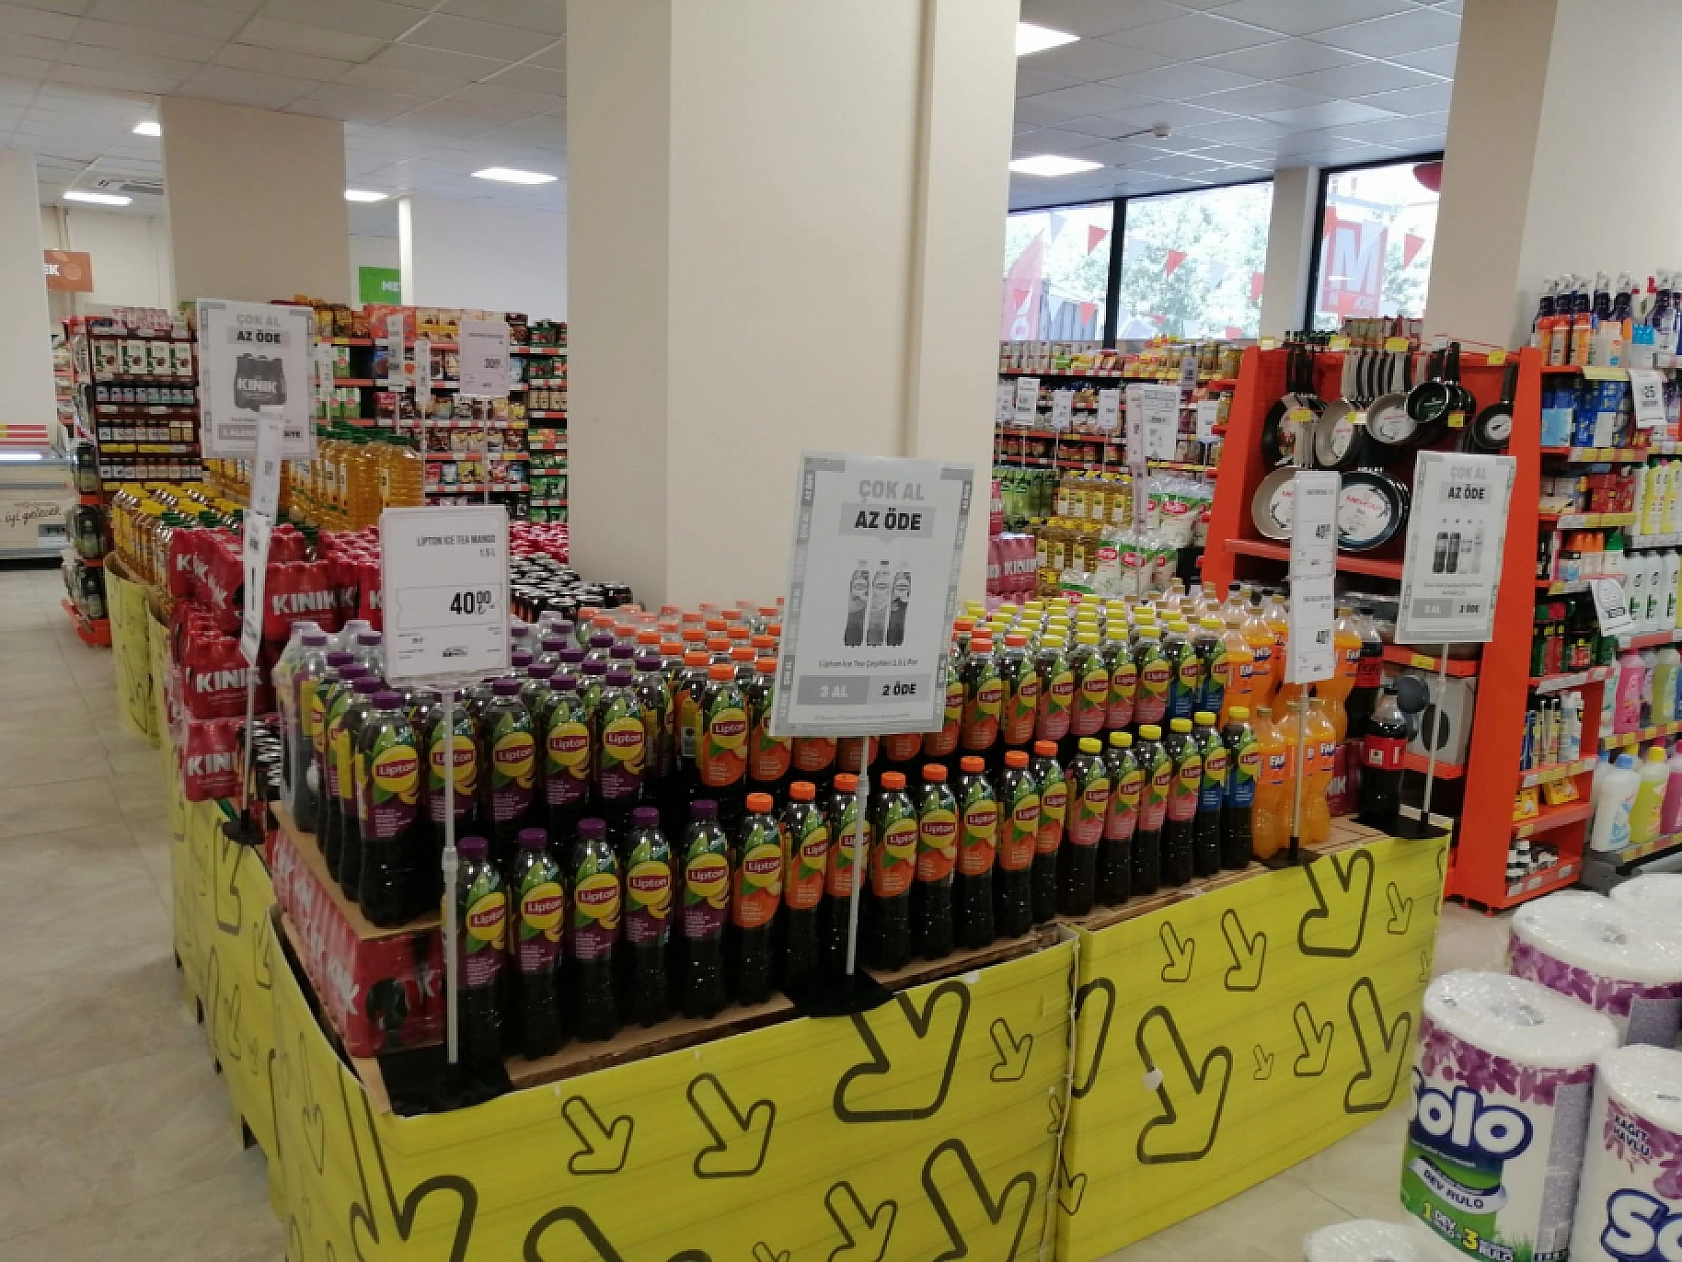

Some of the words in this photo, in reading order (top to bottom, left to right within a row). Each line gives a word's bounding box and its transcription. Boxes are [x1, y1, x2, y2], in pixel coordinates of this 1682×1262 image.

[236, 330, 253, 342] AZ
[255, 328, 282, 344] ÖDE
[859, 479, 897, 504] ÇOK
[902, 482, 925, 501] AL
[1447, 486, 1463, 500] AZ
[1464, 483, 1486, 500] ÖDE
[853, 510, 880, 529] AZ
[884, 506, 923, 532] ÖDE
[443, 536, 455, 545] ICE
[456, 536, 470, 545] TEA
[471, 535, 496, 544] MANGO
[449, 591, 475, 615] 40
[820, 685, 829, 698] 3
[831, 685, 849, 698] AL
[881, 683, 891, 696] 2
[893, 680, 918, 696] ÖDE
[551, 737, 586, 749] Lipton
[608, 732, 642, 744] Lipton
[435, 751, 474, 765] Liton
[925, 823, 954, 834] Lipton
[633, 876, 668, 889] Lipton
[1413, 1084, 1533, 1160] olo
[1423, 1168, 1444, 1191] DEV
[1445, 1188, 1485, 1210] RULO
[1422, 1202, 1433, 1221] 1
[1462, 1227, 1479, 1251] 3
[1599, 1187, 1682, 1262] So
